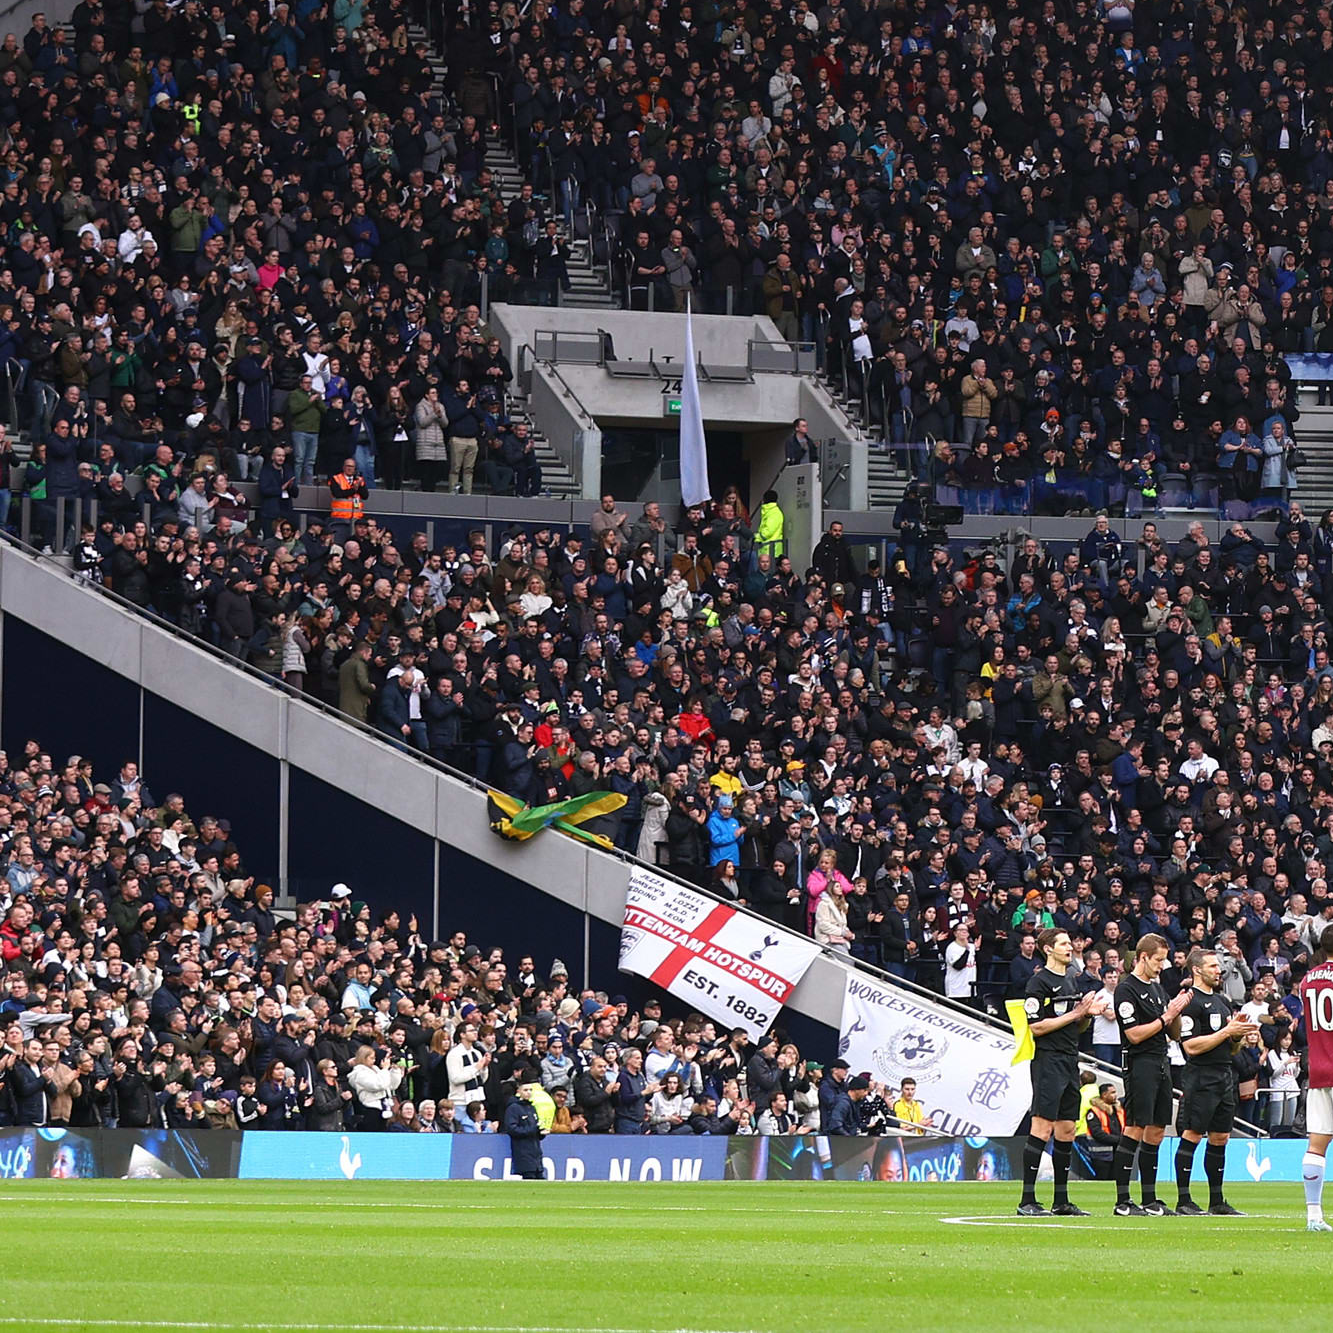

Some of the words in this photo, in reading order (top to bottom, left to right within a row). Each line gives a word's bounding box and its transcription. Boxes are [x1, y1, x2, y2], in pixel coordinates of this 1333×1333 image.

[661, 379, 683, 394] 24
[640, 874, 665, 888] JEZZA
[625, 908, 707, 954] TTENHAM
[703, 949, 789, 998] HOTSPUR
[682, 969, 720, 1000] EST.
[726, 995, 769, 1029] 1882
[848, 978, 986, 1043] WORCESTERSHIRE
